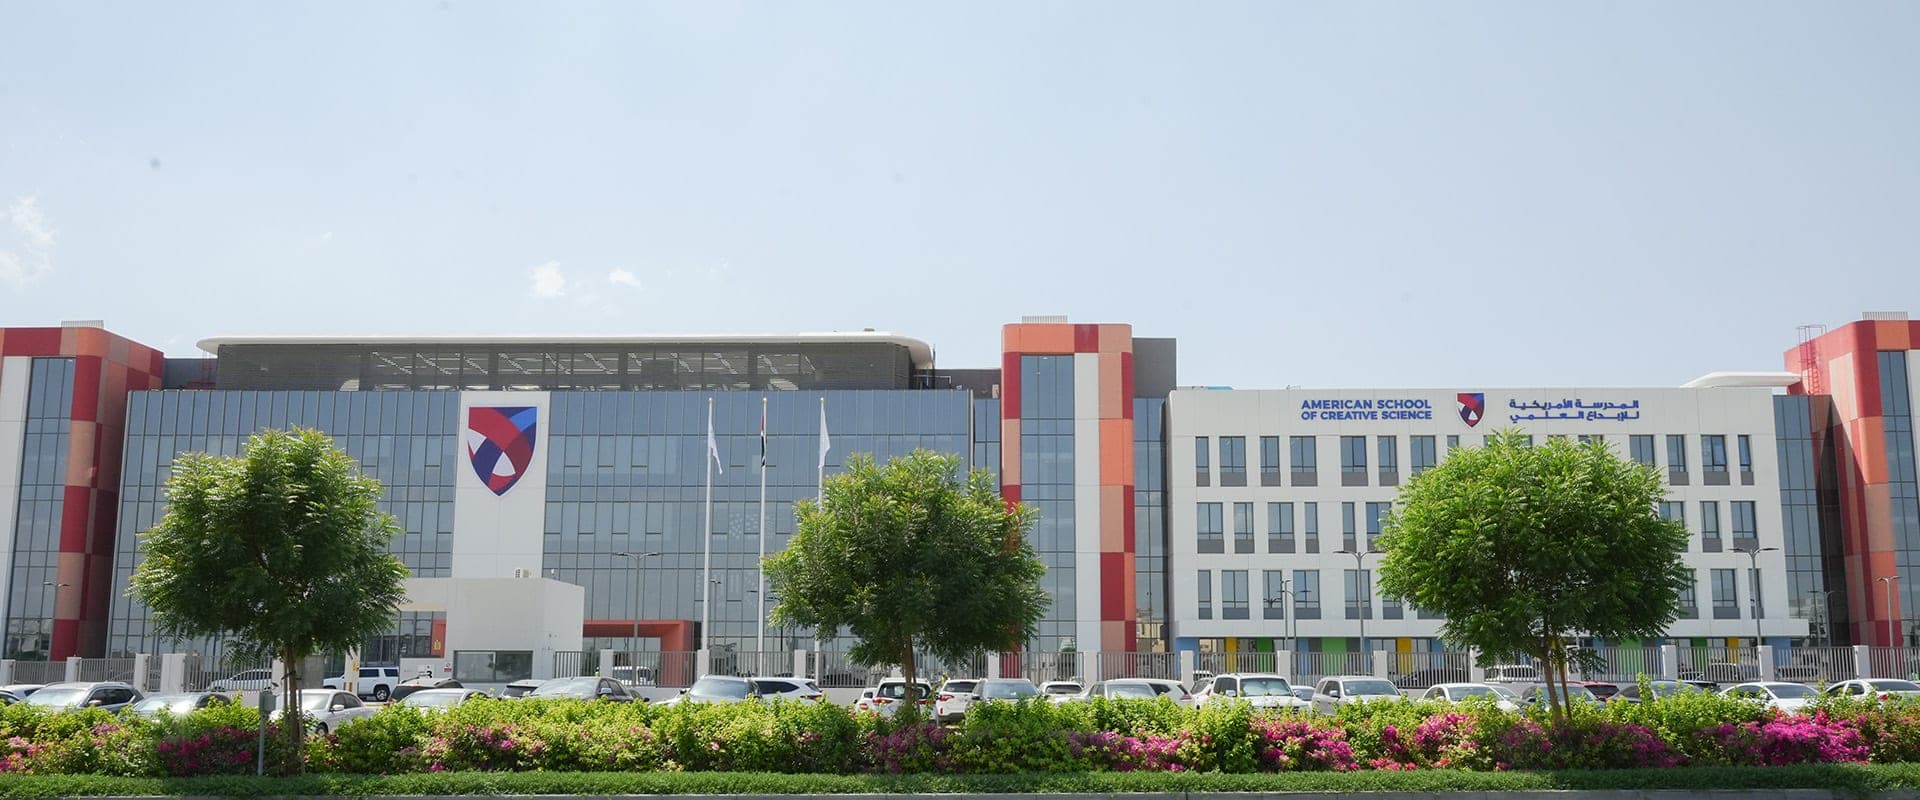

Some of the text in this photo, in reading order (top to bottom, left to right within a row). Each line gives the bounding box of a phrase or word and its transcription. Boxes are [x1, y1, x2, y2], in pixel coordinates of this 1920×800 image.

[1301, 399, 1432, 409] AMERICAN SCHOOL
[1575, 399, 1639, 410] المدرسة
[1301, 411, 1432, 420] OF CREATIVE SCIENCE
[1509, 411, 1584, 423] العلمي
